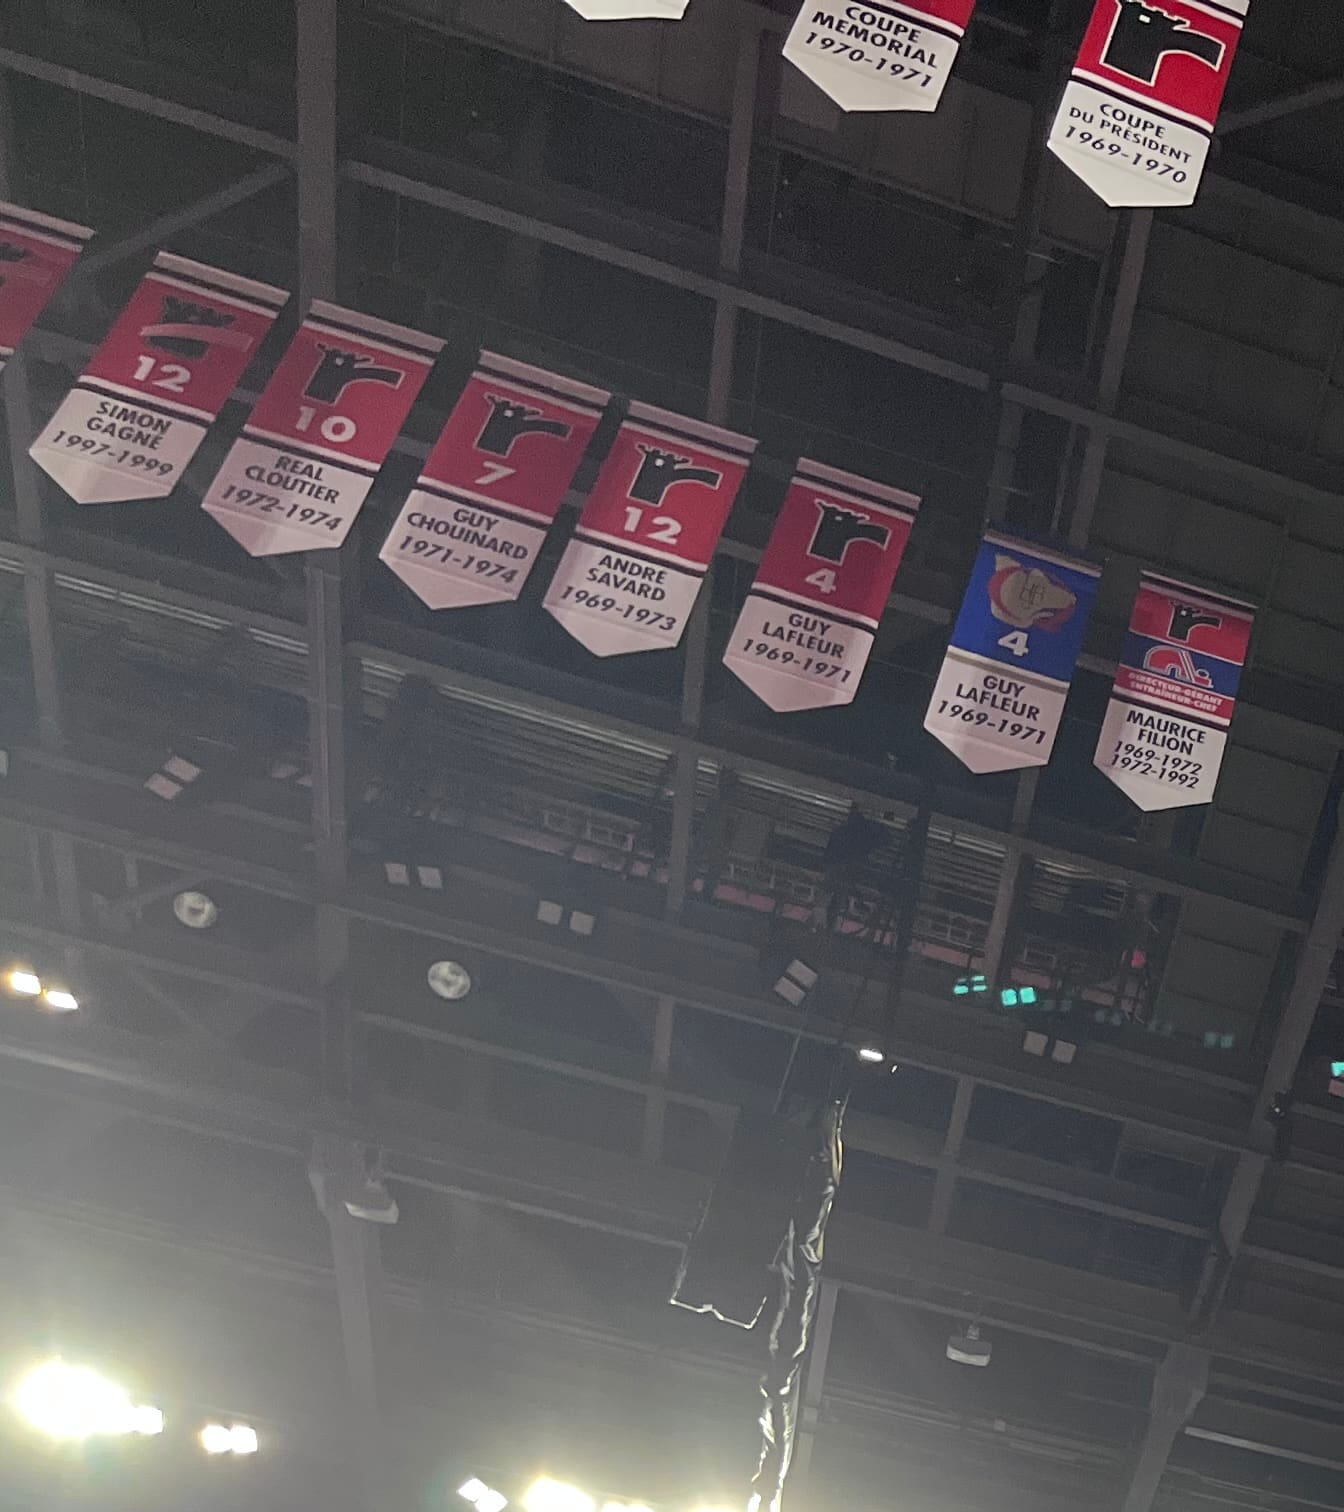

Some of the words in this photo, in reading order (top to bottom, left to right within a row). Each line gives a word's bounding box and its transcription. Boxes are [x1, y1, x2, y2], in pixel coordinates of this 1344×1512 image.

[810, 11, 939, 69] MEMORIAL
[845, 6, 921, 43] COUPE
[804, 31, 933, 90] 1970-1971
[1068, 107, 1095, 126] DU
[1099, 103, 1166, 139] COUPE
[1062, 125, 1188, 184] 1969-1970
[133, 355, 192, 393] 12
[96, 401, 172, 433] SIMON
[295, 405, 356, 442] 10
[53, 430, 174, 477] 1997-1999
[245, 465, 340, 504] CLOUTIER
[475, 460, 516, 485] 7
[221, 485, 343, 532] 1972-1974
[453, 507, 498, 532] GUY
[623, 505, 682, 545] 12
[407, 511, 528, 560] CHOUINARD
[399, 535, 519, 584] 1971-1974
[587, 567, 666, 602] SAVARD
[804, 568, 838, 595] 4
[560, 586, 677, 631] 1969-1973
[787, 612, 832, 637] GUY
[762, 620, 845, 660] LAFLEUR
[997, 630, 1031, 657] 4
[741, 638, 853, 684] 1969-1971
[955, 682, 1041, 722] LAFLEUR
[982, 674, 1027, 700] GUY
[936, 699, 1047, 745] 1969-1971
[1126, 710, 1207, 744] MAURICE
[1112, 740, 1203, 776] 1969-1972
[1137, 729, 1194, 756] FILION
[1110, 754, 1200, 789] 1972-1992
